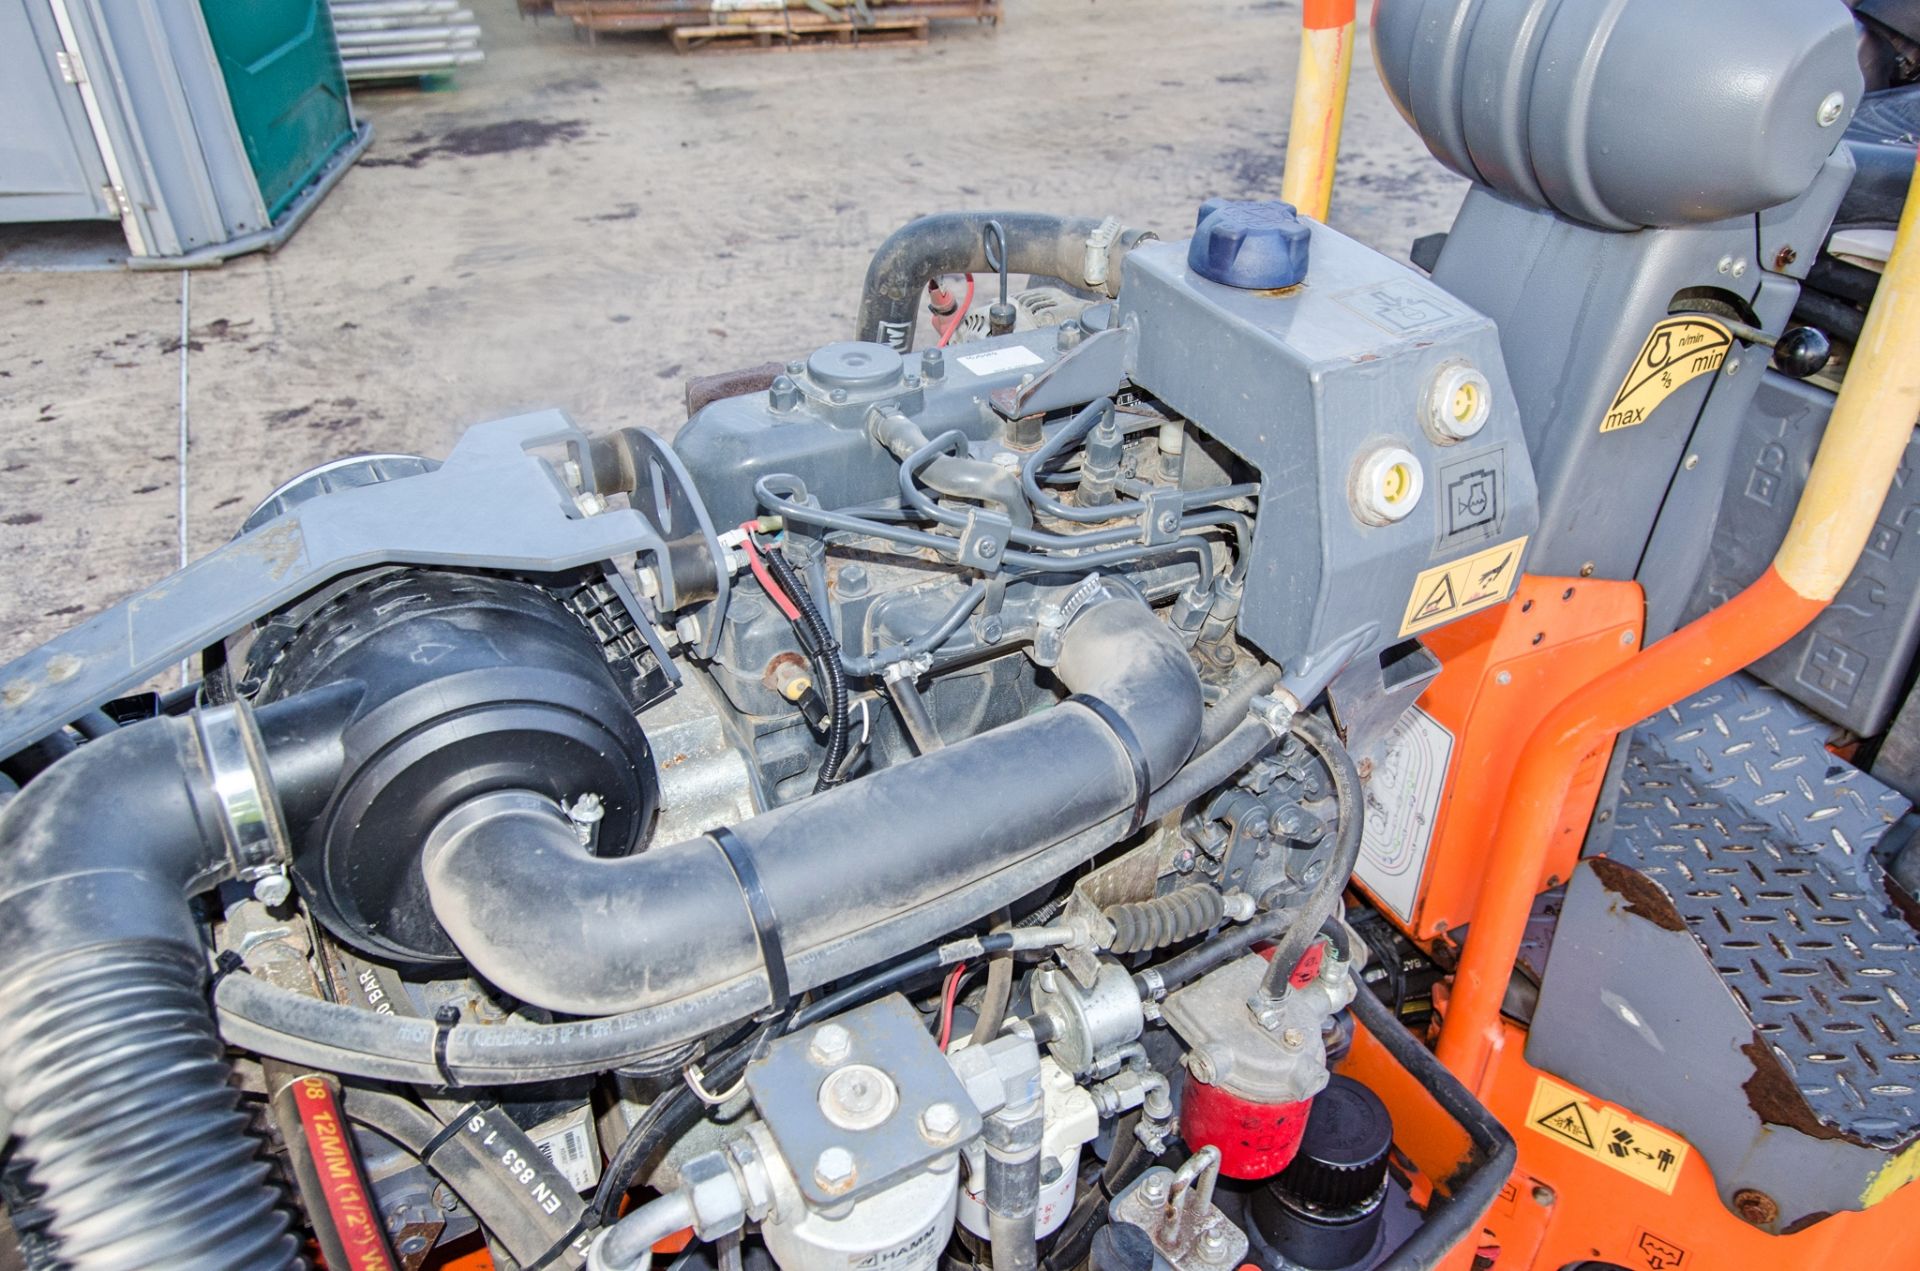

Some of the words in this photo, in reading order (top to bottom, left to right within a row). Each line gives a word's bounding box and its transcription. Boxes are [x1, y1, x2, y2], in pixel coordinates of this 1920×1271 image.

[1678, 333, 1704, 346] n/min
[1691, 349, 1723, 373] min
[1605, 406, 1645, 430] max
[359, 968, 384, 1005] BAR
[313, 1111, 352, 1179] 12MM
[483, 1131, 498, 1146] 1
[501, 1148, 536, 1185] 853
[530, 1182, 562, 1216] EN
[882, 1225, 936, 1262] HAMM
